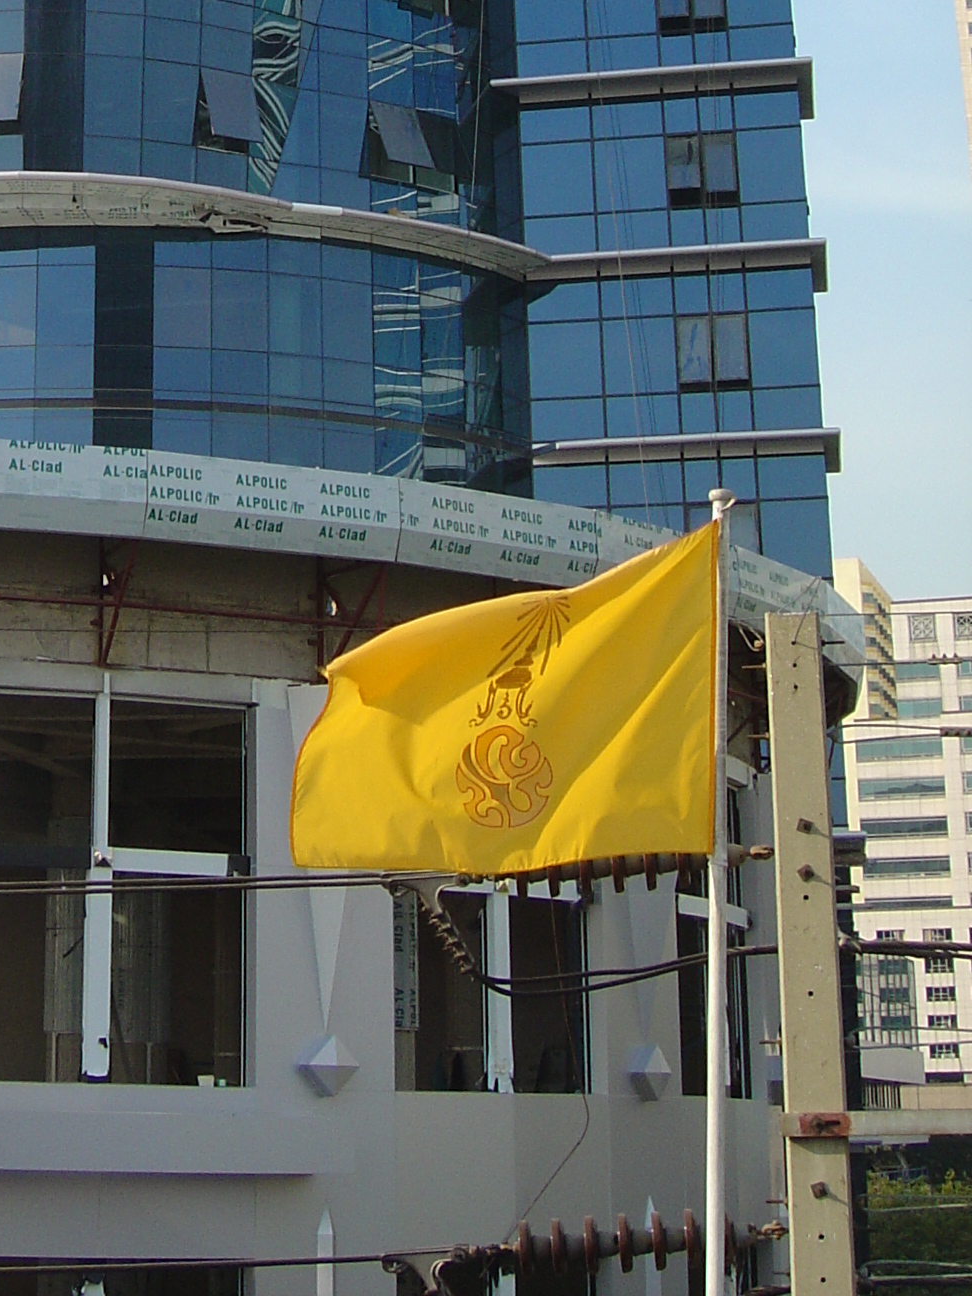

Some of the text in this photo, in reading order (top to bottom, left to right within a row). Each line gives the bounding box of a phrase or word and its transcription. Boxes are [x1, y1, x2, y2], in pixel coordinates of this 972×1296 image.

[8, 458, 62, 473] AL-Clad
[150, 464, 370, 499] ALPOLIC ALPOLIC ALPOLIC
[148, 508, 367, 542] AL-Clad AL-Clad AL-Clad
[432, 497, 474, 514] ALPOLIC
[501, 508, 542, 525] ALPOLIC
[430, 538, 472, 555] AL-Clad
[500, 550, 540, 566] AL-Clad
